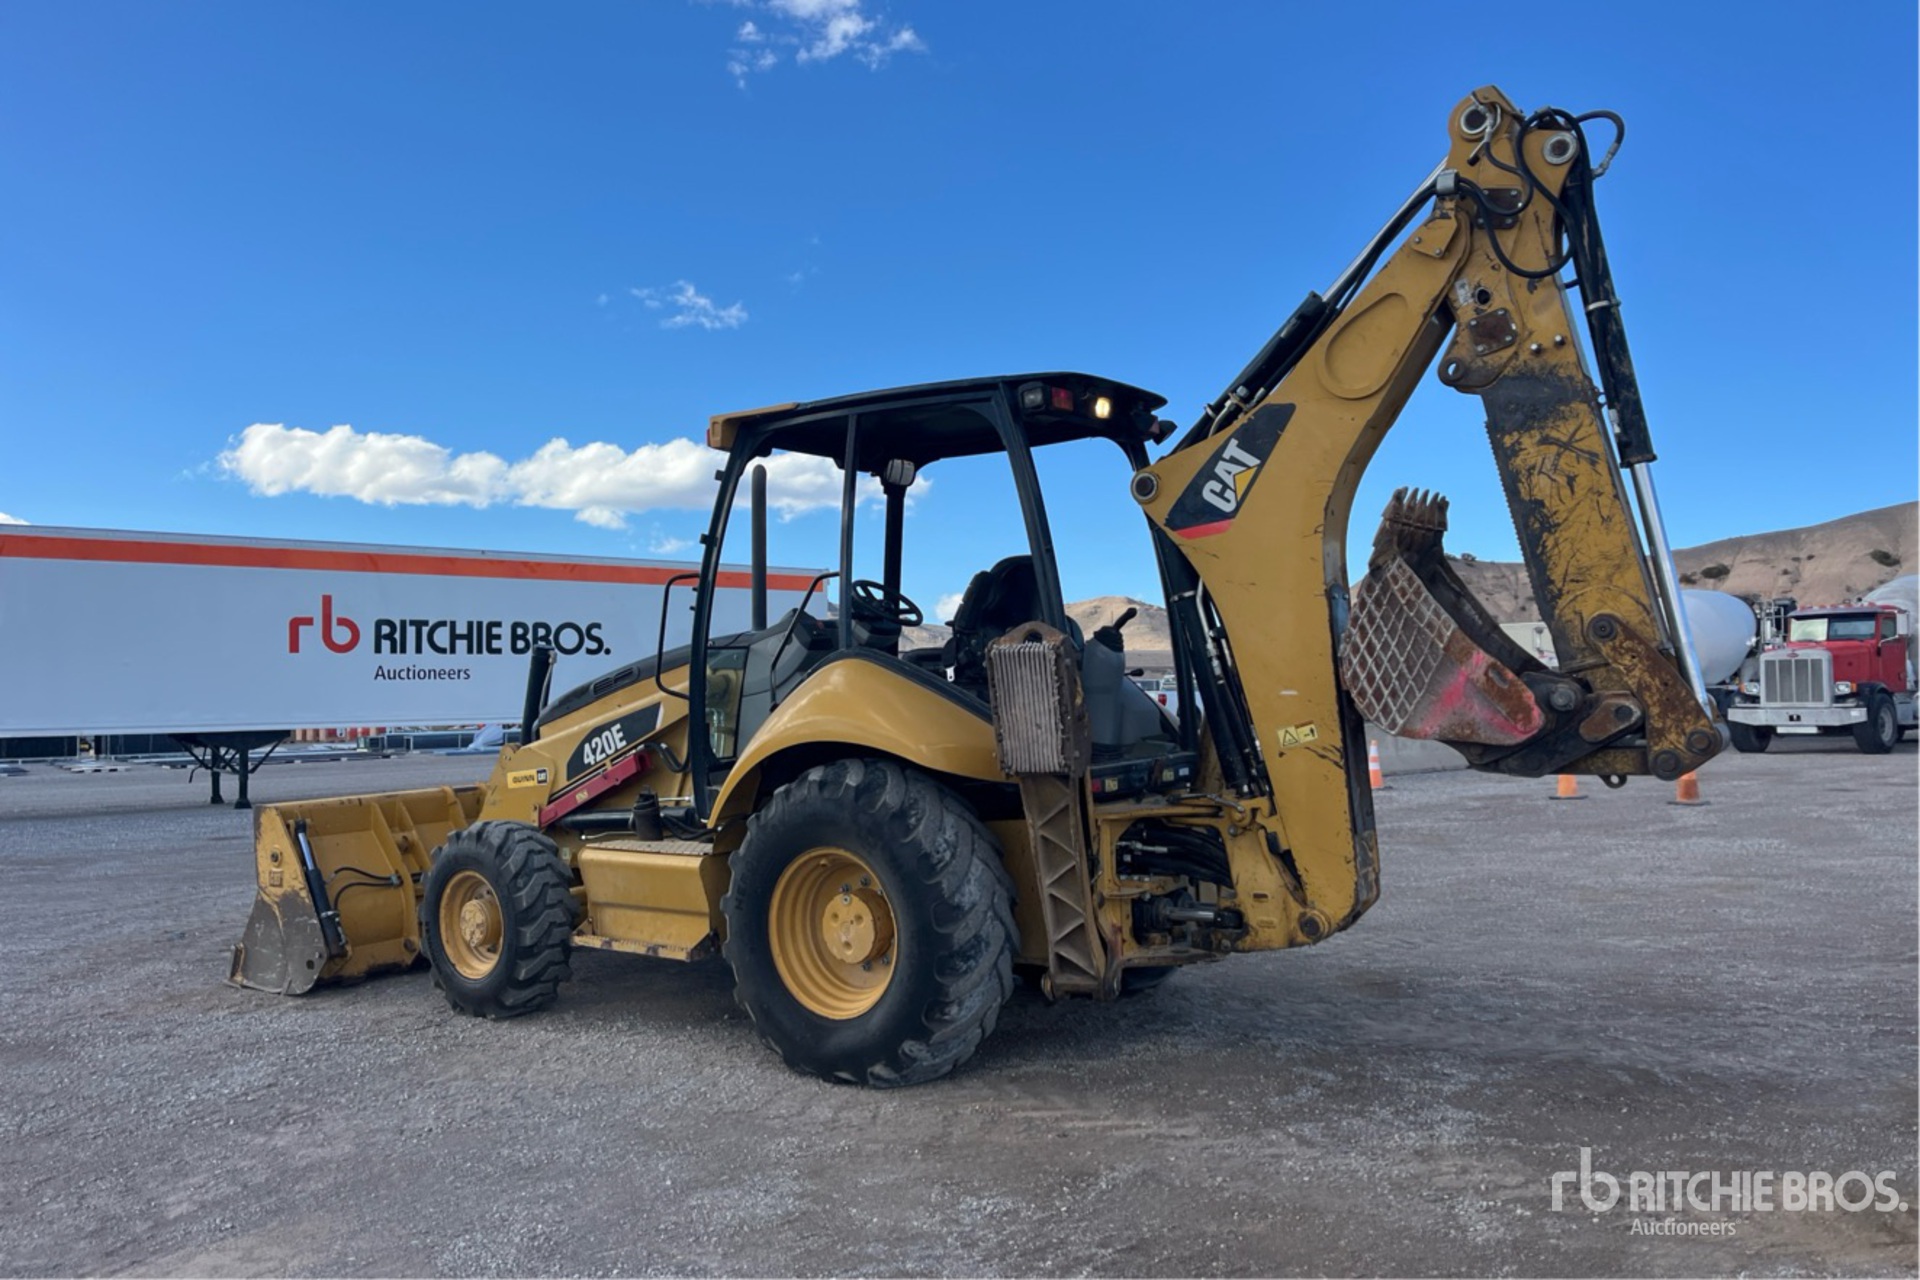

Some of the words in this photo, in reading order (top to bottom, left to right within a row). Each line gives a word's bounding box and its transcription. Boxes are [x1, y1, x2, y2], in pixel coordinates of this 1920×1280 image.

[1202, 437, 1261, 513] CAT
[373, 618, 503, 655] RITCHIE
[510, 621, 612, 656] BROS.
[373, 665, 471, 681] Auctioneers
[583, 722, 628, 766] 420E
